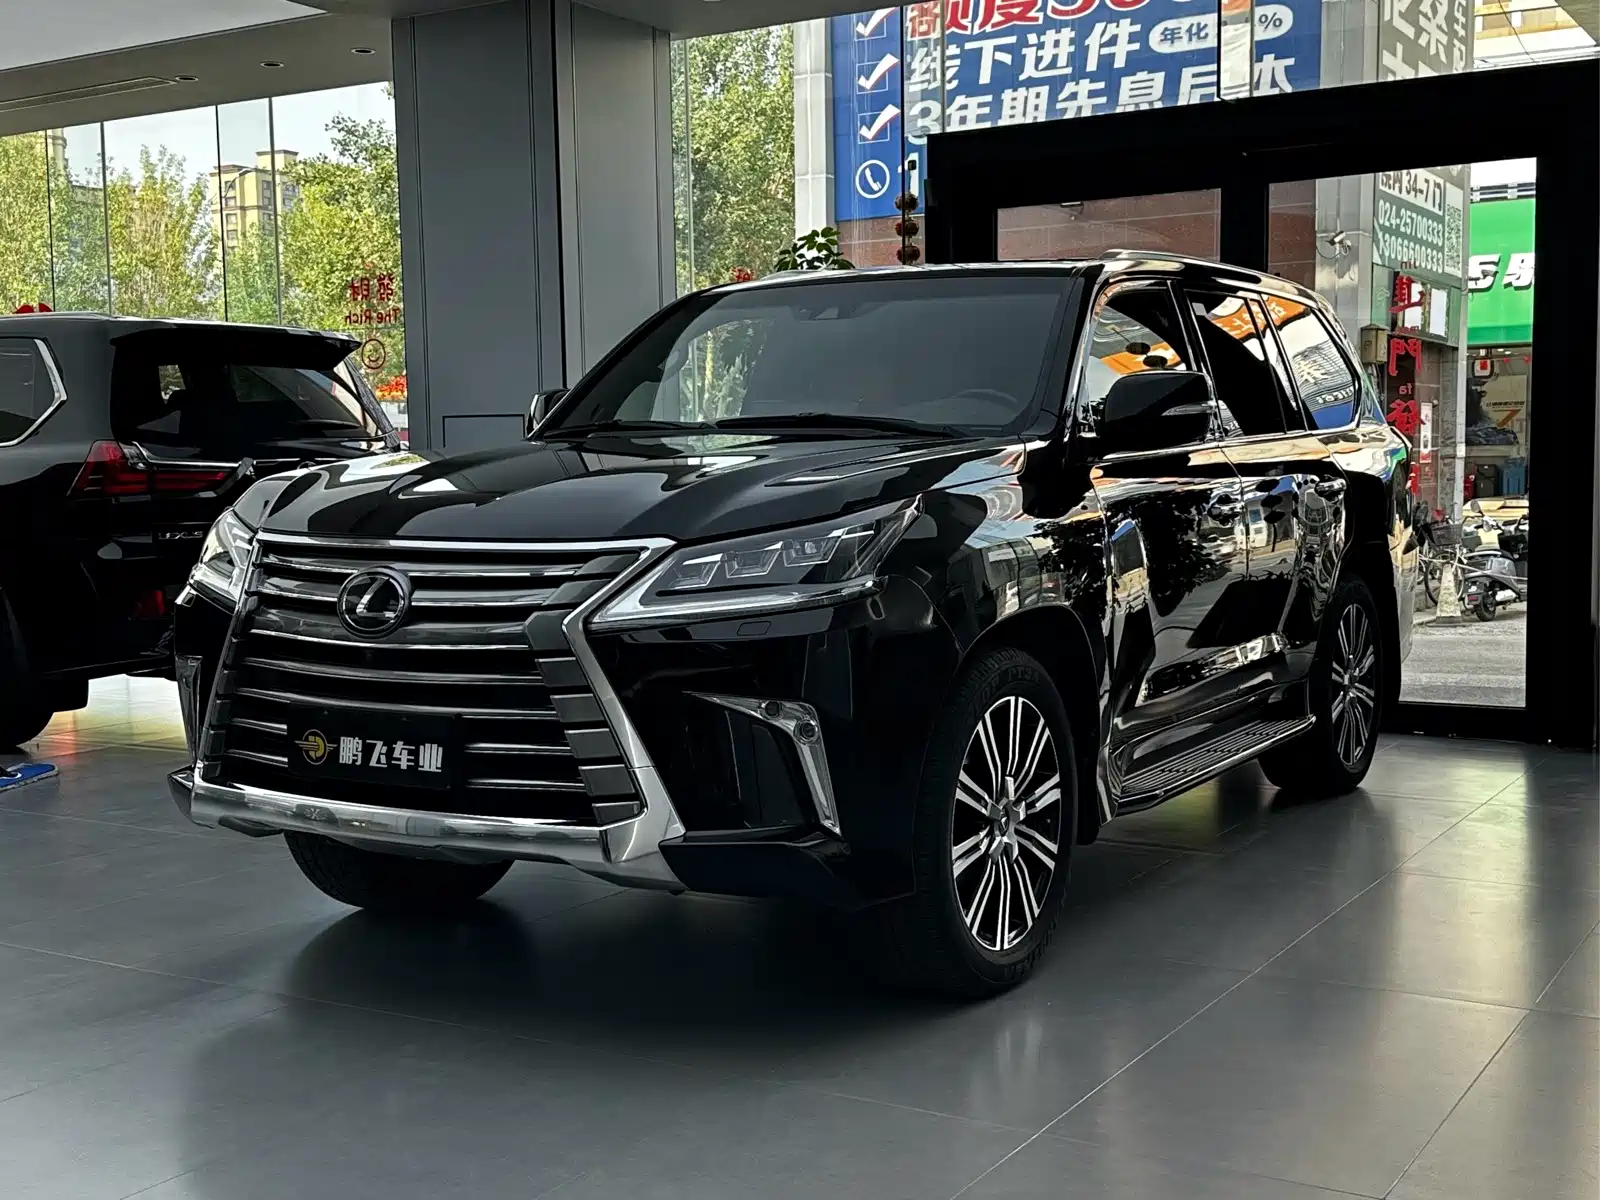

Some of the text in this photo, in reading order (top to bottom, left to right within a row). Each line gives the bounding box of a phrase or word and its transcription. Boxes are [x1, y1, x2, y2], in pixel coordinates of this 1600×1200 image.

[908, 12, 1283, 93] 线下进件 年化 %
[1378, 199, 1443, 246] 024-25700333
[339, 736, 443, 773] 鹏飞车业
